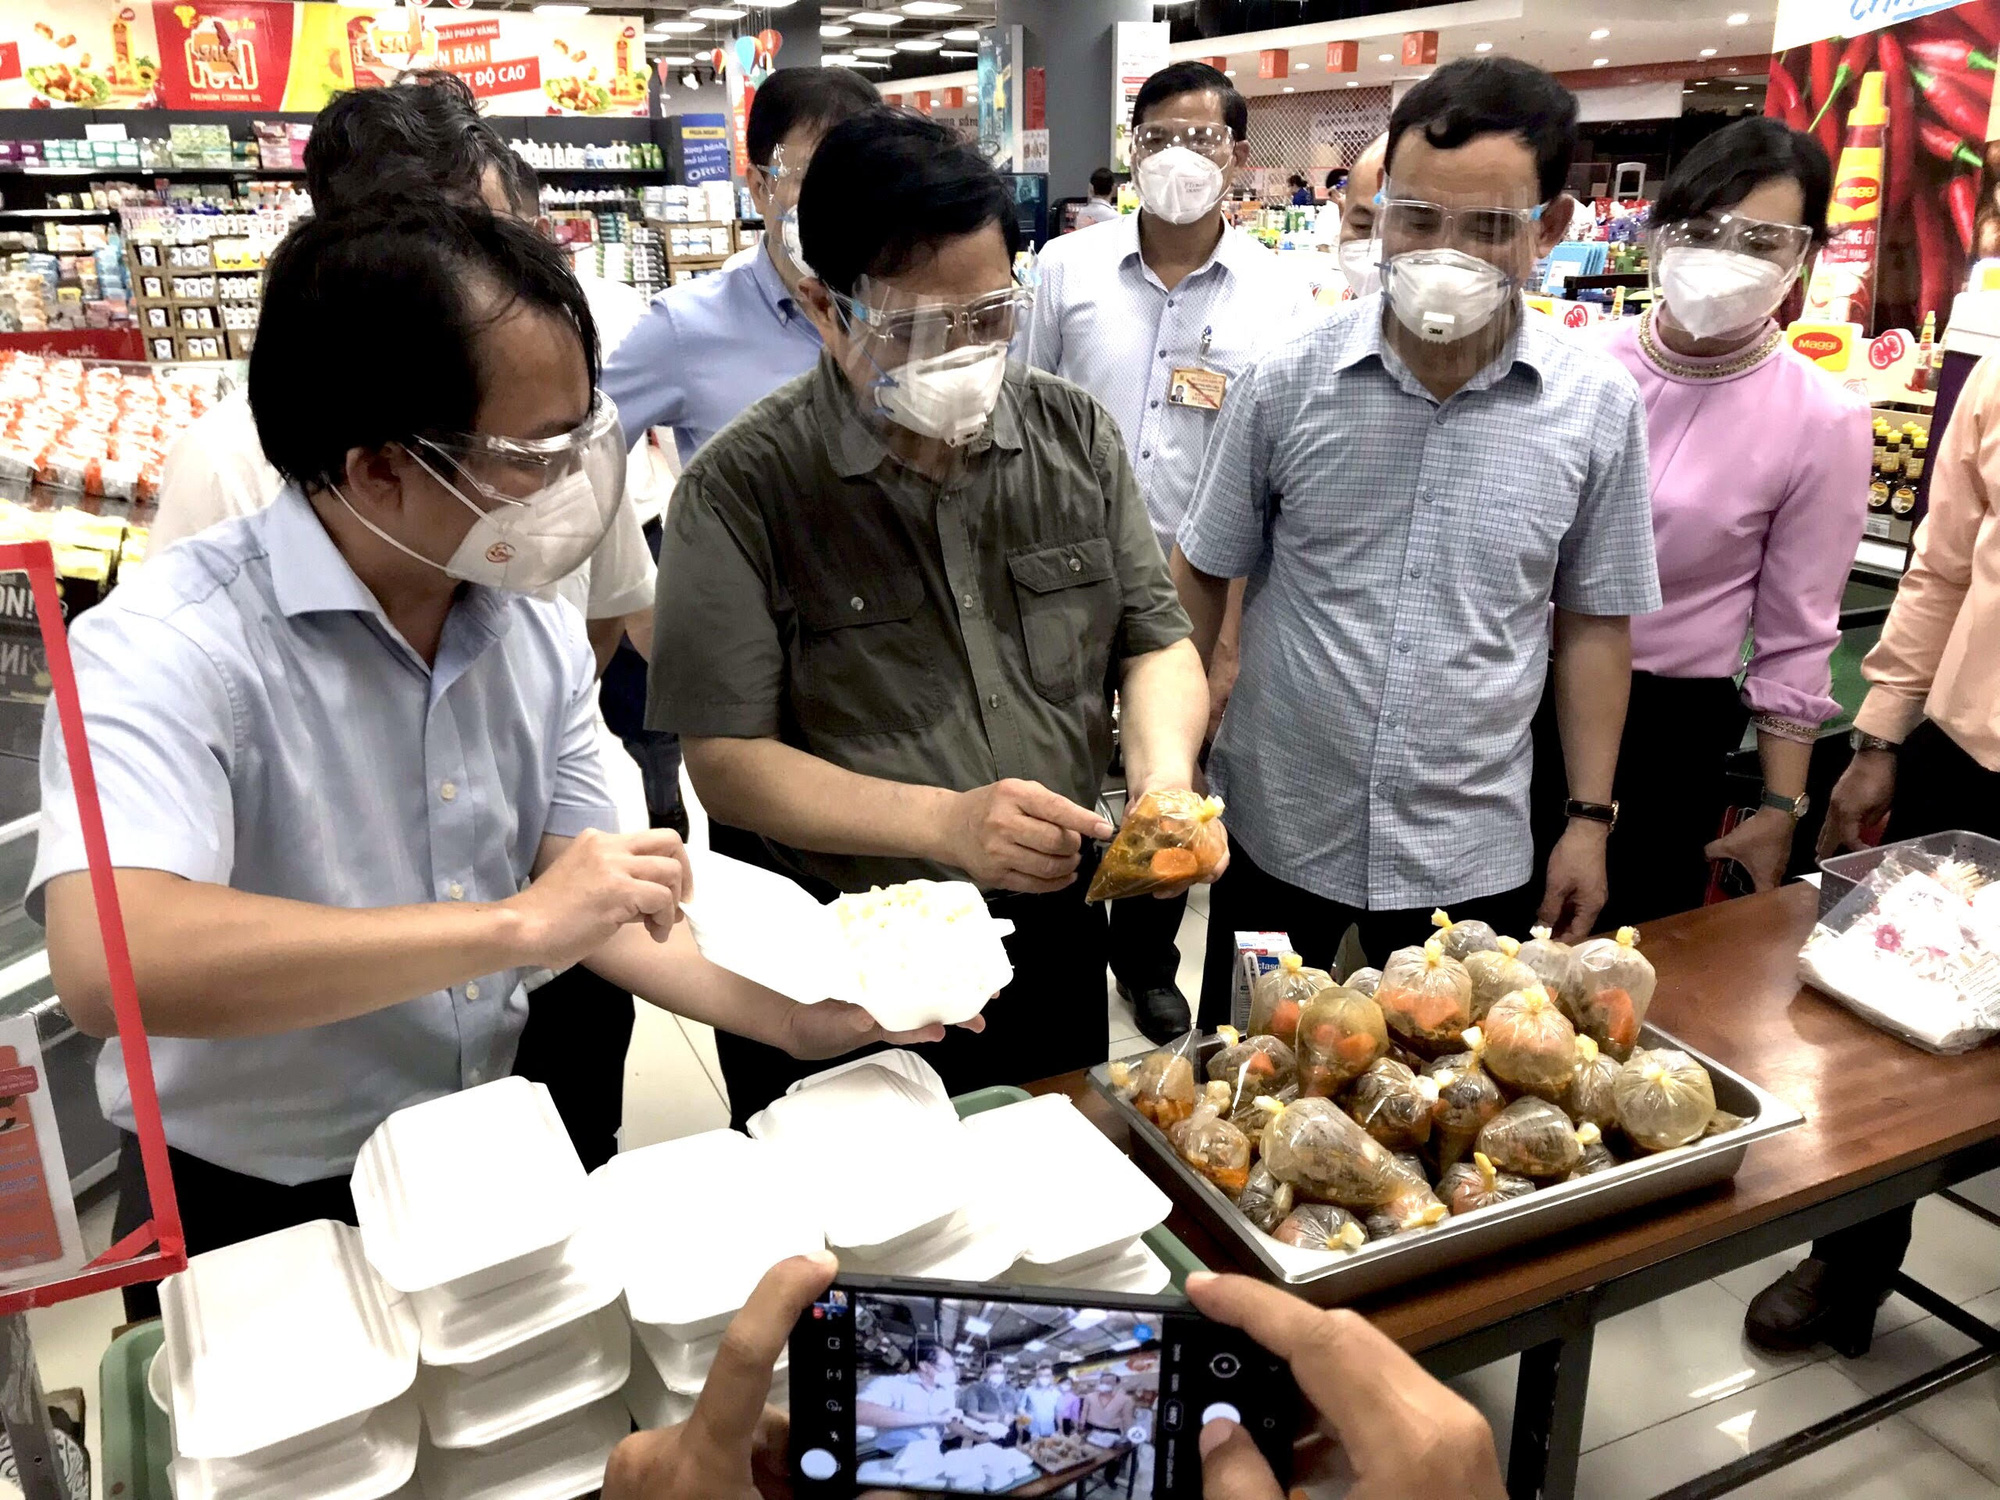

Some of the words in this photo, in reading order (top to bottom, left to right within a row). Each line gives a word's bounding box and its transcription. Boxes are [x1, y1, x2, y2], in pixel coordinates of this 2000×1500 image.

[453, 43, 487, 65] RÁN
[1327, 48, 1342, 67] 10
[1409, 40, 1417, 58] 9
[475, 66, 496, 89] ĐỘ
[498, 64, 526, 83] CAO
[687, 166, 726, 181] OREO
[1798, 339, 1837, 351] Maggi
